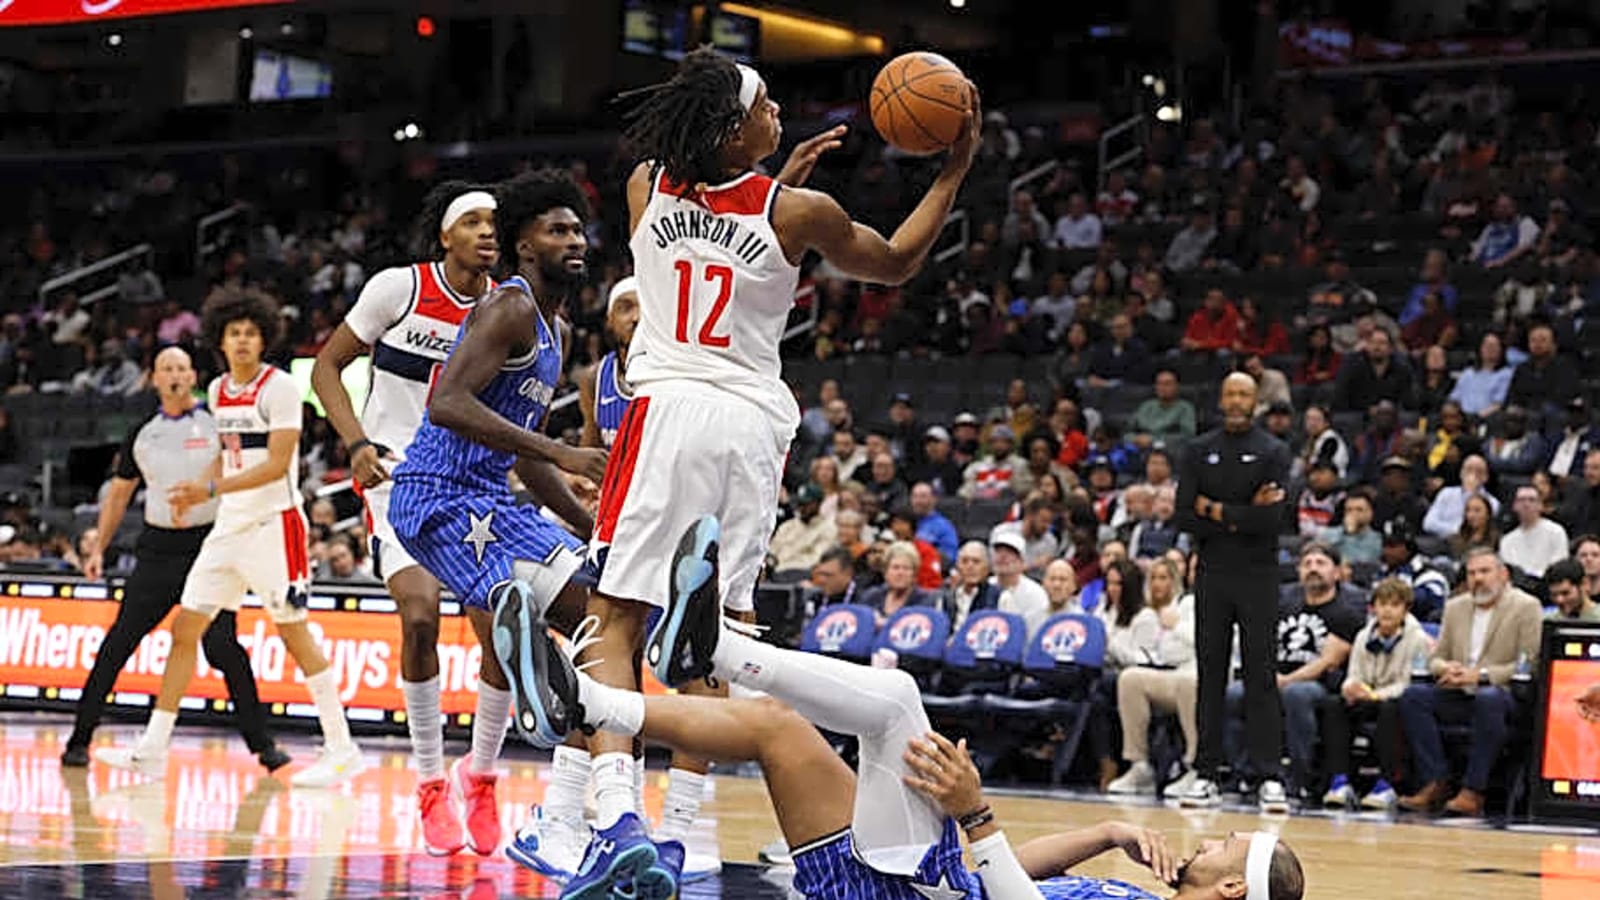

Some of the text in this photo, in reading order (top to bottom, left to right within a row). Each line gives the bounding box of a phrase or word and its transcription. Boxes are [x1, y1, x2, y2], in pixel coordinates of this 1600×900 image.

[650, 210, 769, 264] JOHNSON III
[674, 259, 734, 348] 12
[0, 606, 105, 671] Where
[124, 630, 173, 676] he
